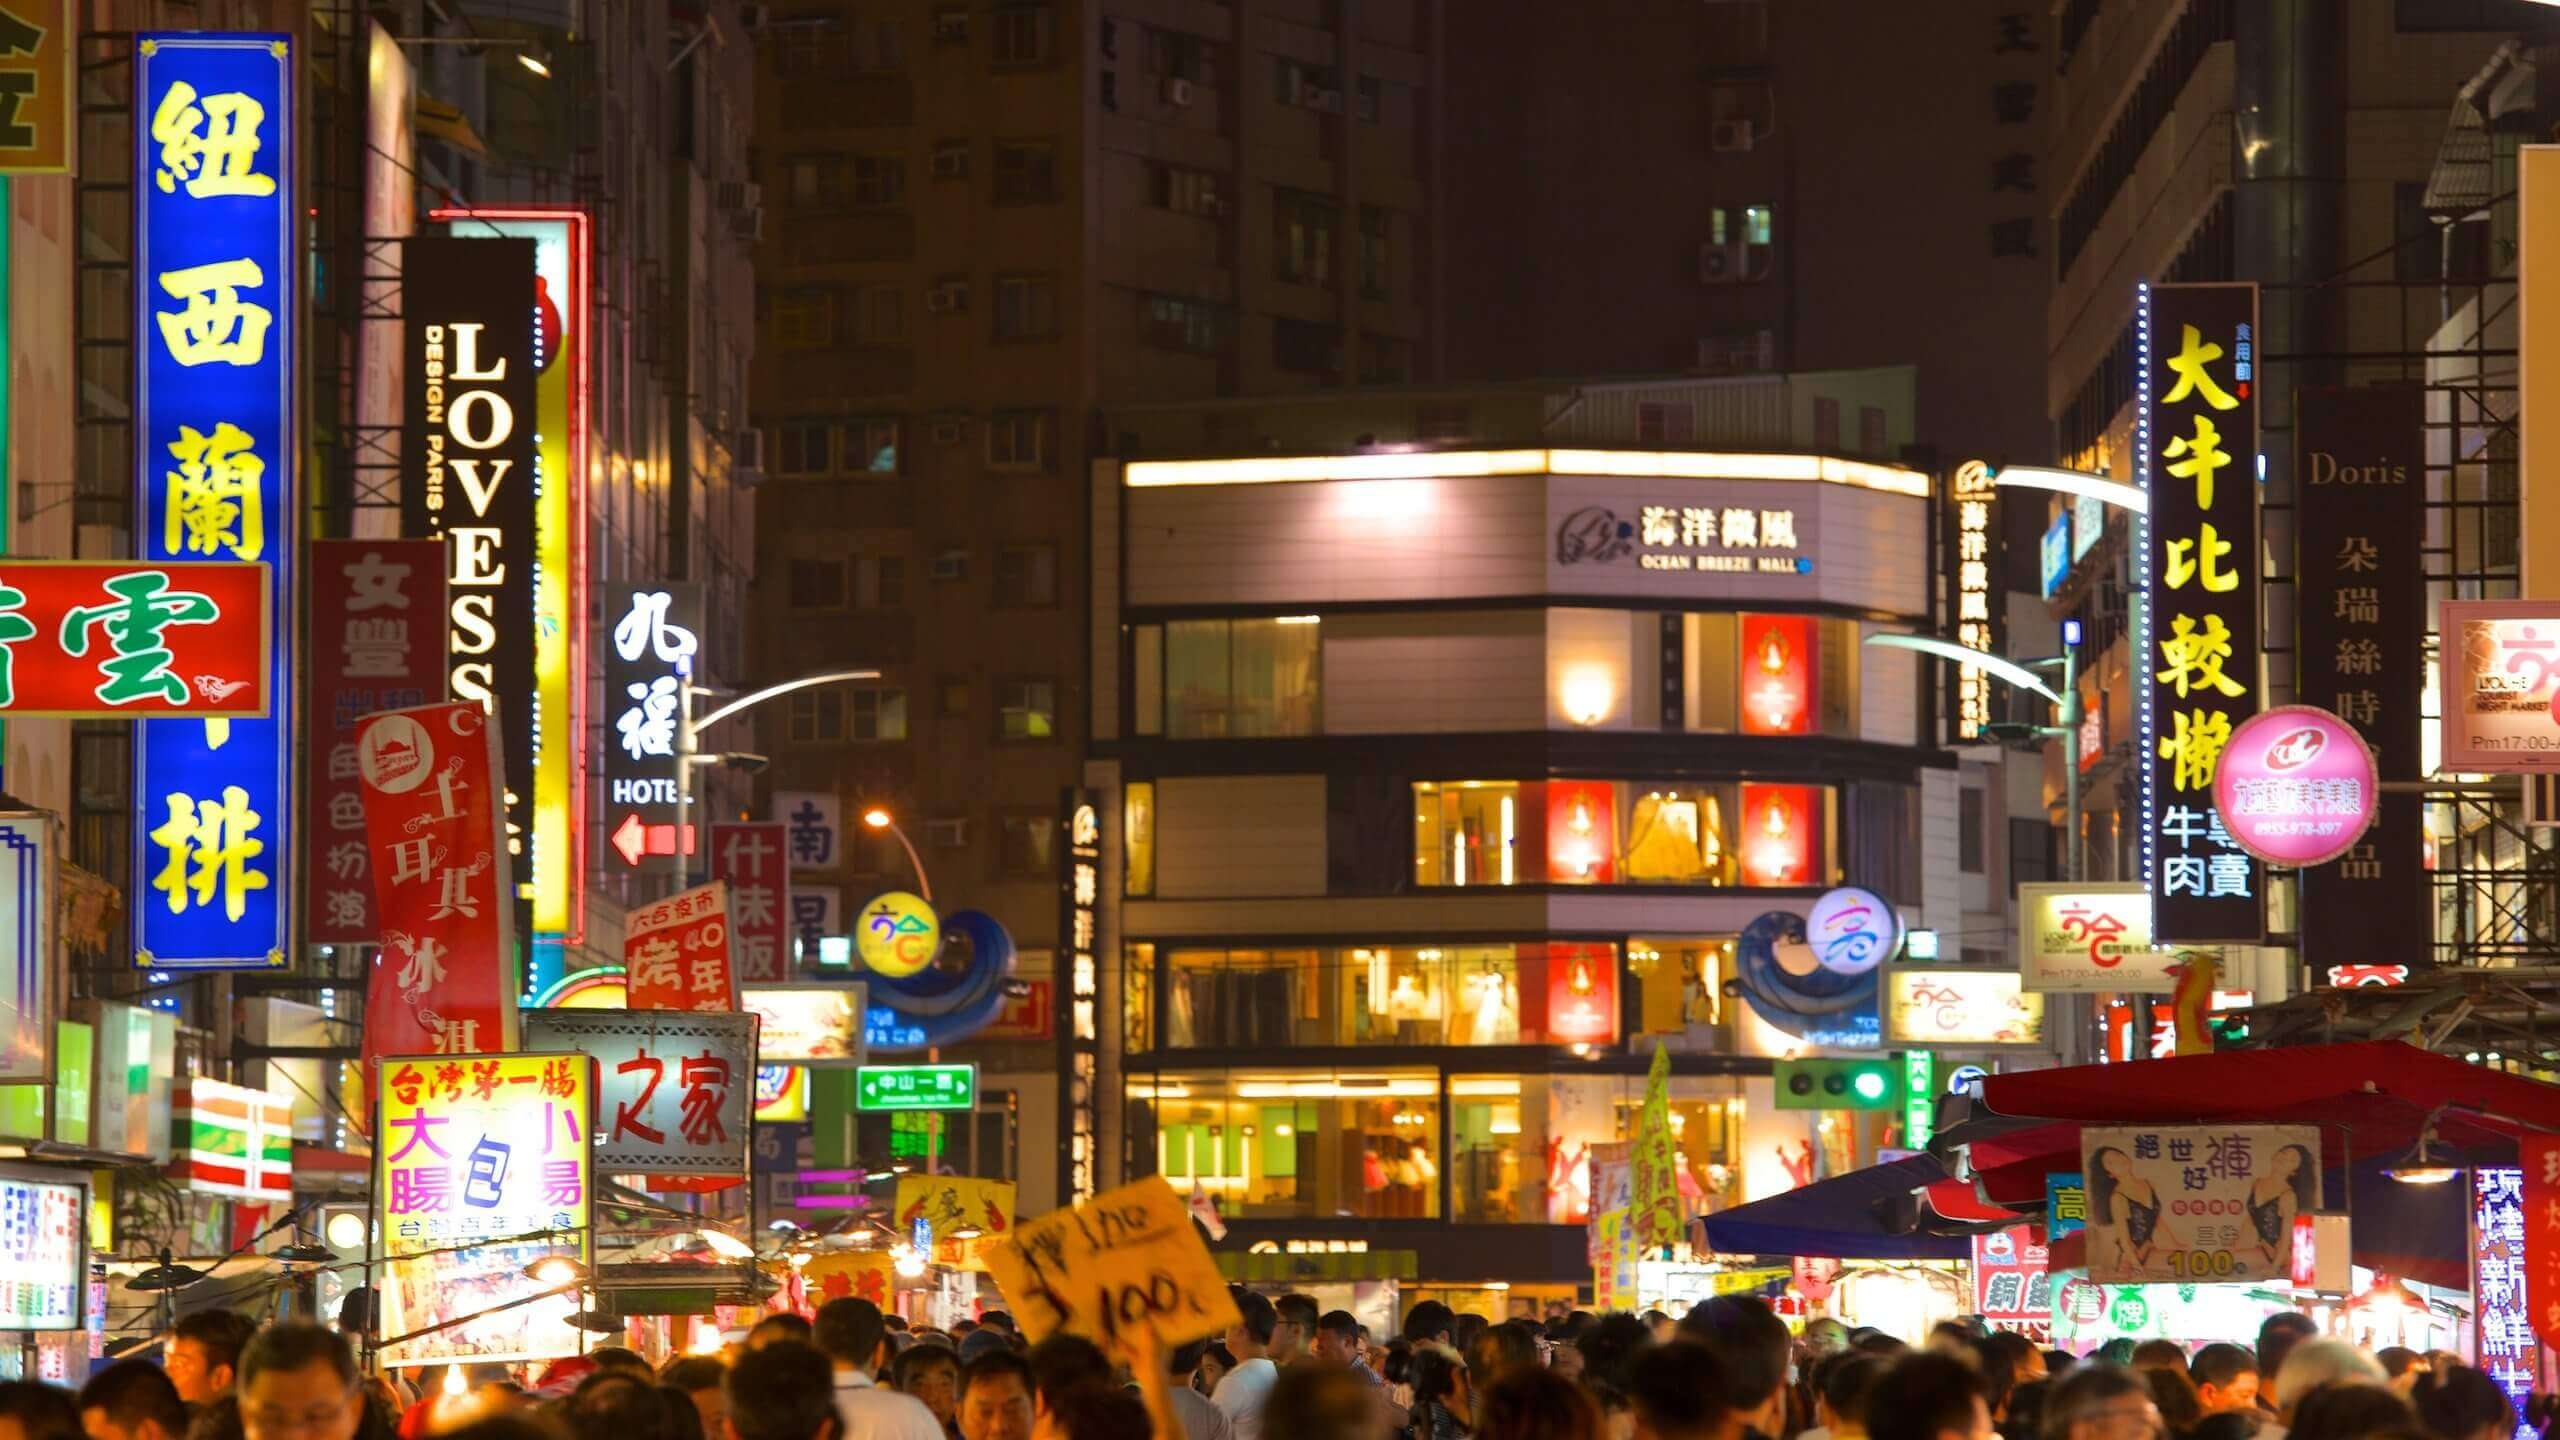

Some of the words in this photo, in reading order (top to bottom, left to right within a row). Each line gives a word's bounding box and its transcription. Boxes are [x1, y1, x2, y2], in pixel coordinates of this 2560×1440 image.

[425, 325, 445, 423] DESIGN
[150, 80, 277, 923] 紐西蘭排
[426, 434, 445, 511] PARIS
[2310, 453, 2407, 485] Doris
[1640, 554, 1691, 570] OCEAN
[1696, 556, 1750, 571] BREEZE
[1757, 557, 1797, 573] MALL
[1641, 507, 1797, 548] 海洋微風
[2154, 323, 2247, 792] 大牛比較懶
[0, 570, 221, 707] 雲
[341, 552, 412, 678] 女豐
[2334, 536, 2383, 880] 朵瑞絲時品
[388, 1056, 577, 1106] 台灣第一腸
[590, 1047, 730, 1146] 之家
[387, 1107, 453, 1214] 大腸
[2168, 1250, 2235, 1277] 100
